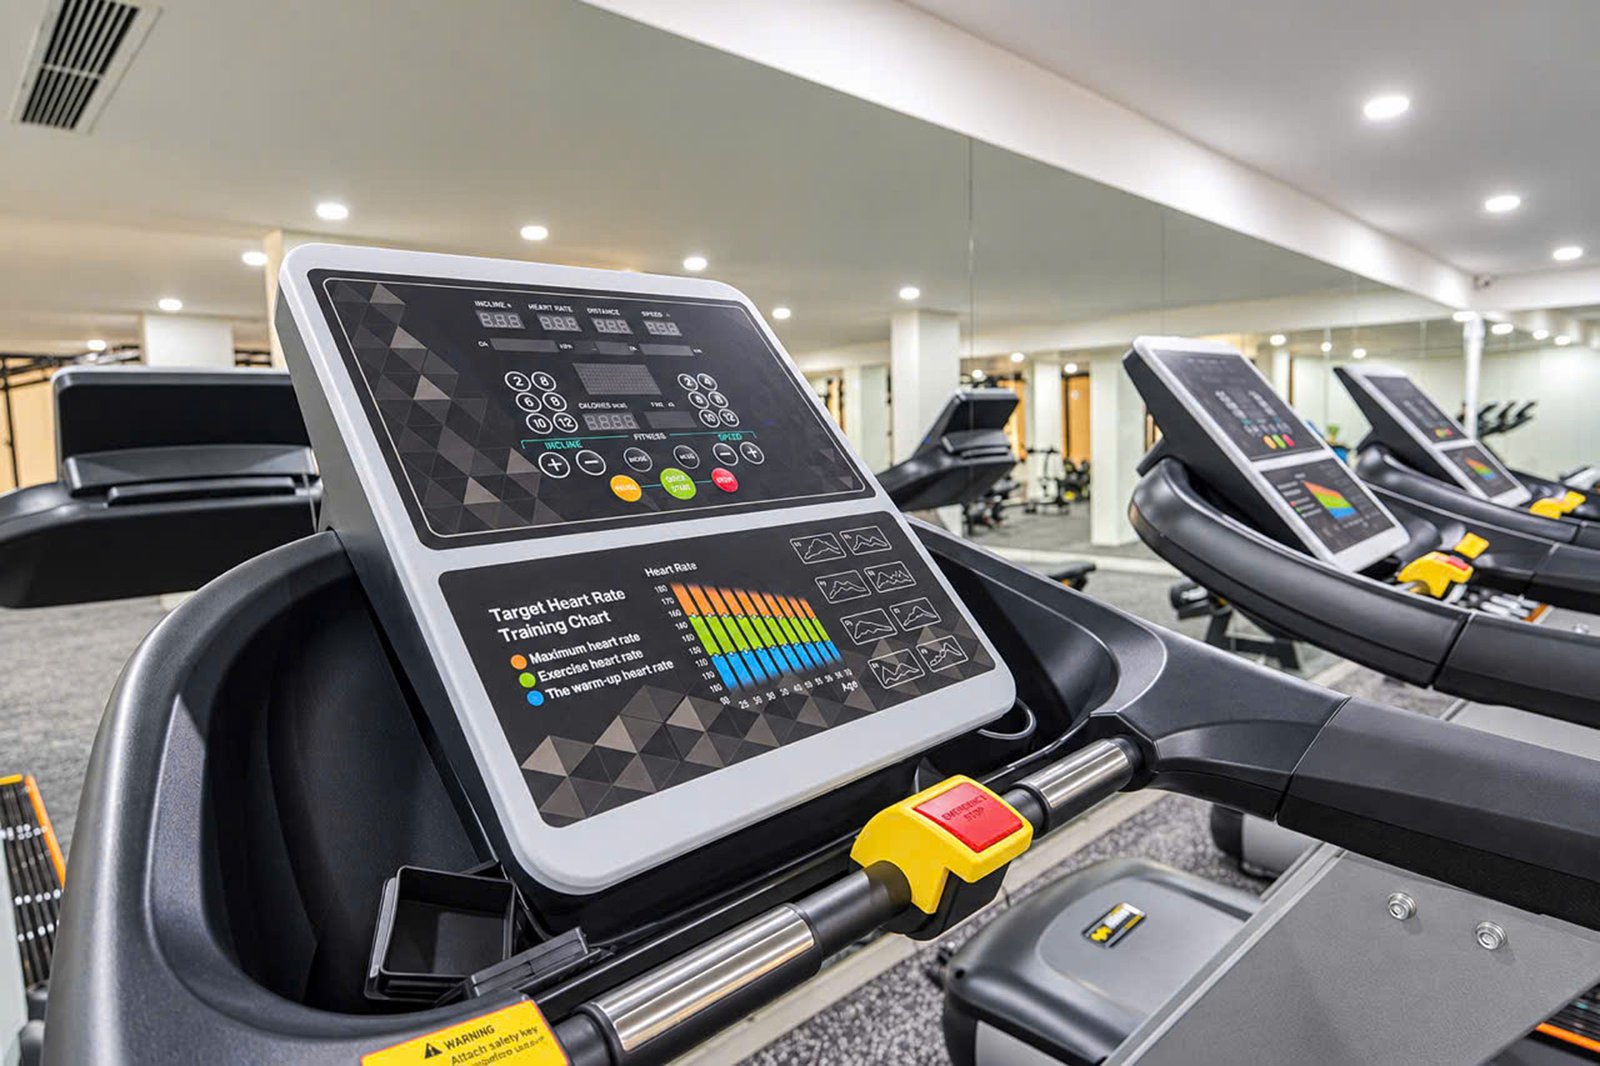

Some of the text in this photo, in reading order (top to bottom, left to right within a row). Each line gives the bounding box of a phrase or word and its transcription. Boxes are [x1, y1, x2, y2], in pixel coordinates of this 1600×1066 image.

[586, 307, 621, 316] DISTANCE
[512, 376, 524, 387] 2
[683, 377, 693, 387] 2
[523, 396, 534, 408] 6
[533, 417, 547, 429] 10
[559, 416, 575, 428] 12
[722, 412, 735, 423] 12
[544, 440, 583, 450] INCLINE
[644, 561, 698, 578] Heart Rate
[488, 588, 626, 622] Target Heart Rate
[497, 610, 612, 643] Training Chart
[528, 632, 641, 665] Maximum heart rate
[537, 648, 645, 683] Exercise heart rate
[545, 657, 675, 701] The warm-up heart rate
[963, 806, 985, 823] STOP
[444, 1024, 495, 1050] WARNING
[451, 1044, 488, 1066] Attach
[488, 1033, 519, 1051] safety
[520, 1025, 538, 1039] key
